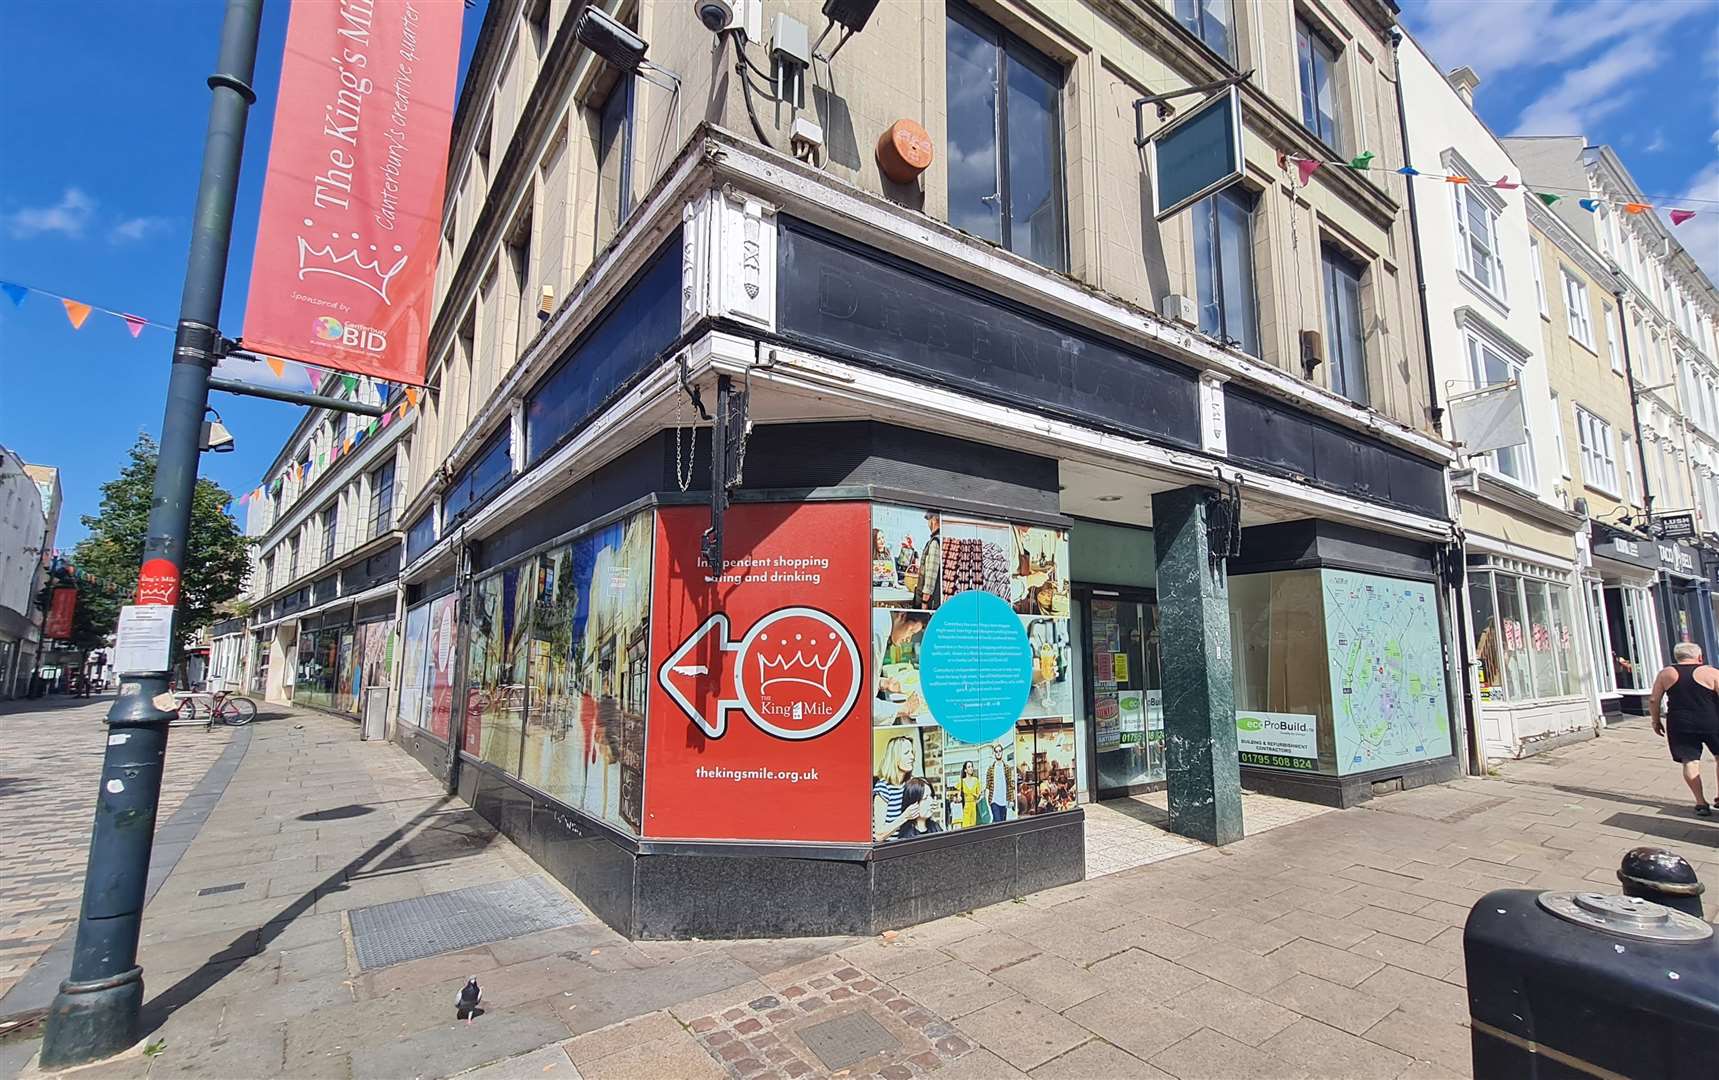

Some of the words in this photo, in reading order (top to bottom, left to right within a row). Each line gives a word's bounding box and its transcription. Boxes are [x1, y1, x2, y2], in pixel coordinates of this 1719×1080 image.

[400, 2, 421, 62] quarter
[323, 48, 373, 147] King's
[391, 63, 413, 127] creative
[313, 149, 355, 210] The
[375, 128, 409, 231] Canterbury's
[339, 304, 351, 313] by
[342, 326, 387, 351] BID
[697, 556, 771, 572] Inpendent
[773, 555, 829, 569] shopping
[705, 572, 742, 585] ating
[745, 571, 767, 583] and
[770, 571, 821, 584] drinking
[803, 701, 833, 715] Mile
[1264, 720, 1306, 732] ProBuild
[1241, 753, 1270, 765] 01795
[1272, 757, 1290, 767] 508
[696, 766, 818, 782] thekingsmile.org.uk
